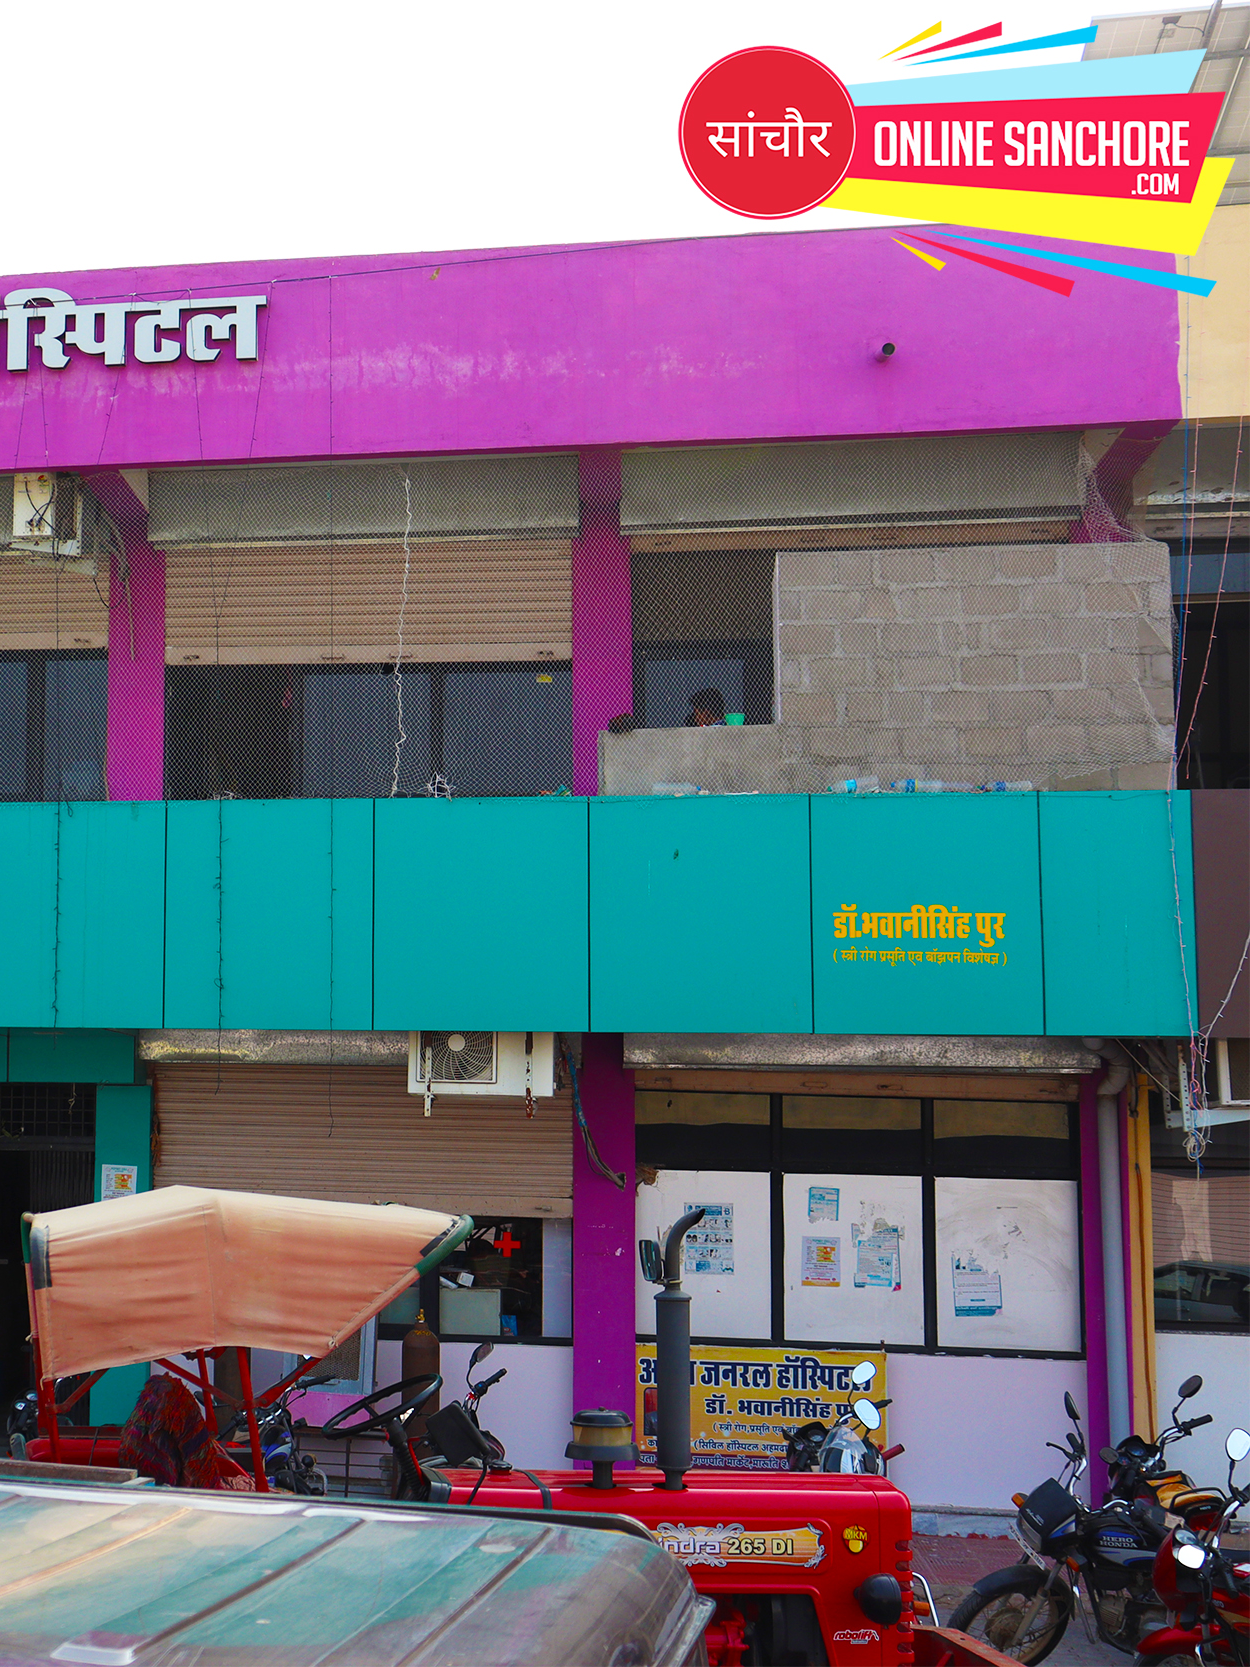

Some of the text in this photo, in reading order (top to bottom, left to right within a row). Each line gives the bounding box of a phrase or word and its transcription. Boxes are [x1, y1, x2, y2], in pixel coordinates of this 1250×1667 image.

[833, 903, 1007, 947] डॉ.भवानीसिंह पुर
[859, 946, 877, 961] रोग
[699, 1360, 773, 1388] जनरल
[738, 1396, 832, 1419] भवानीसिंह
[727, 1537, 765, 1555] 265
[772, 1538, 793, 1555] DI
[1099, 1540, 1138, 1548] HONDA
[1102, 1535, 1134, 1543] HERO
